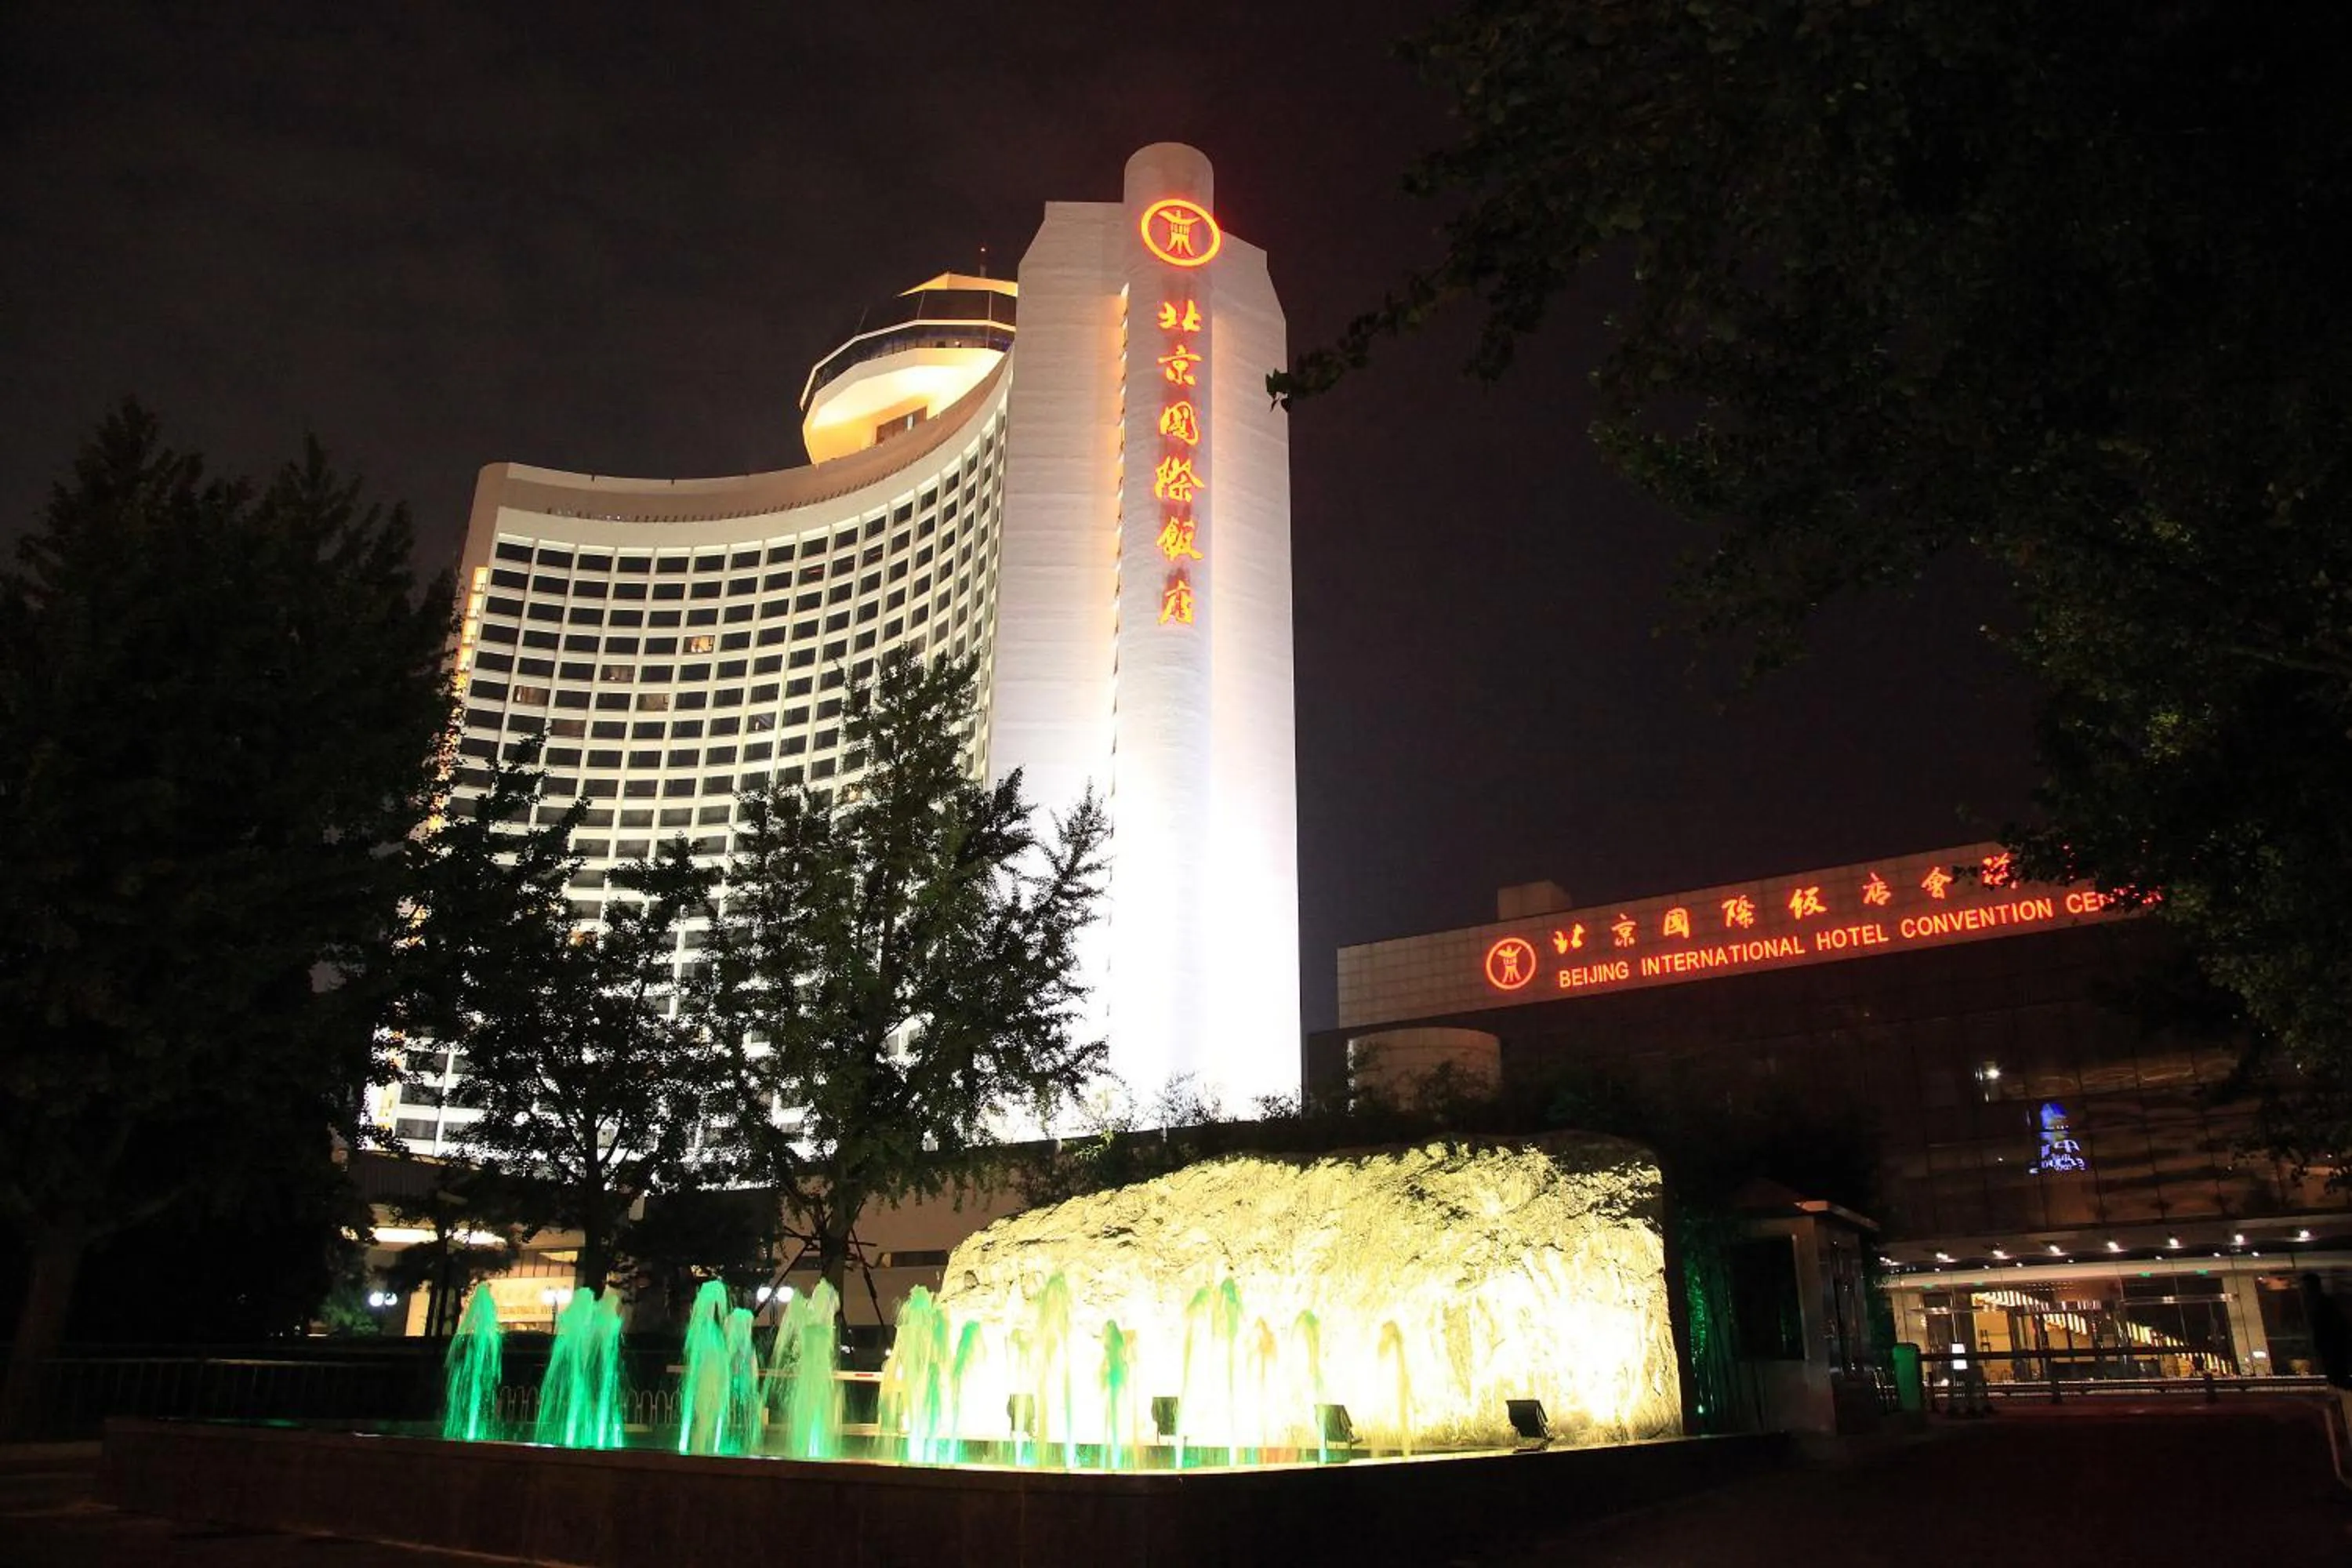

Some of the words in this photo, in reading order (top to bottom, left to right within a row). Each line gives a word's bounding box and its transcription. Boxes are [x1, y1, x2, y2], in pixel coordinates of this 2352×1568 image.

[1559, 960, 1630, 989] BEIJING
[1641, 935, 1806, 977] INTERNATIONAL
[1816, 924, 1889, 951] HOTEL
[1900, 898, 2053, 938] CONVENTION
